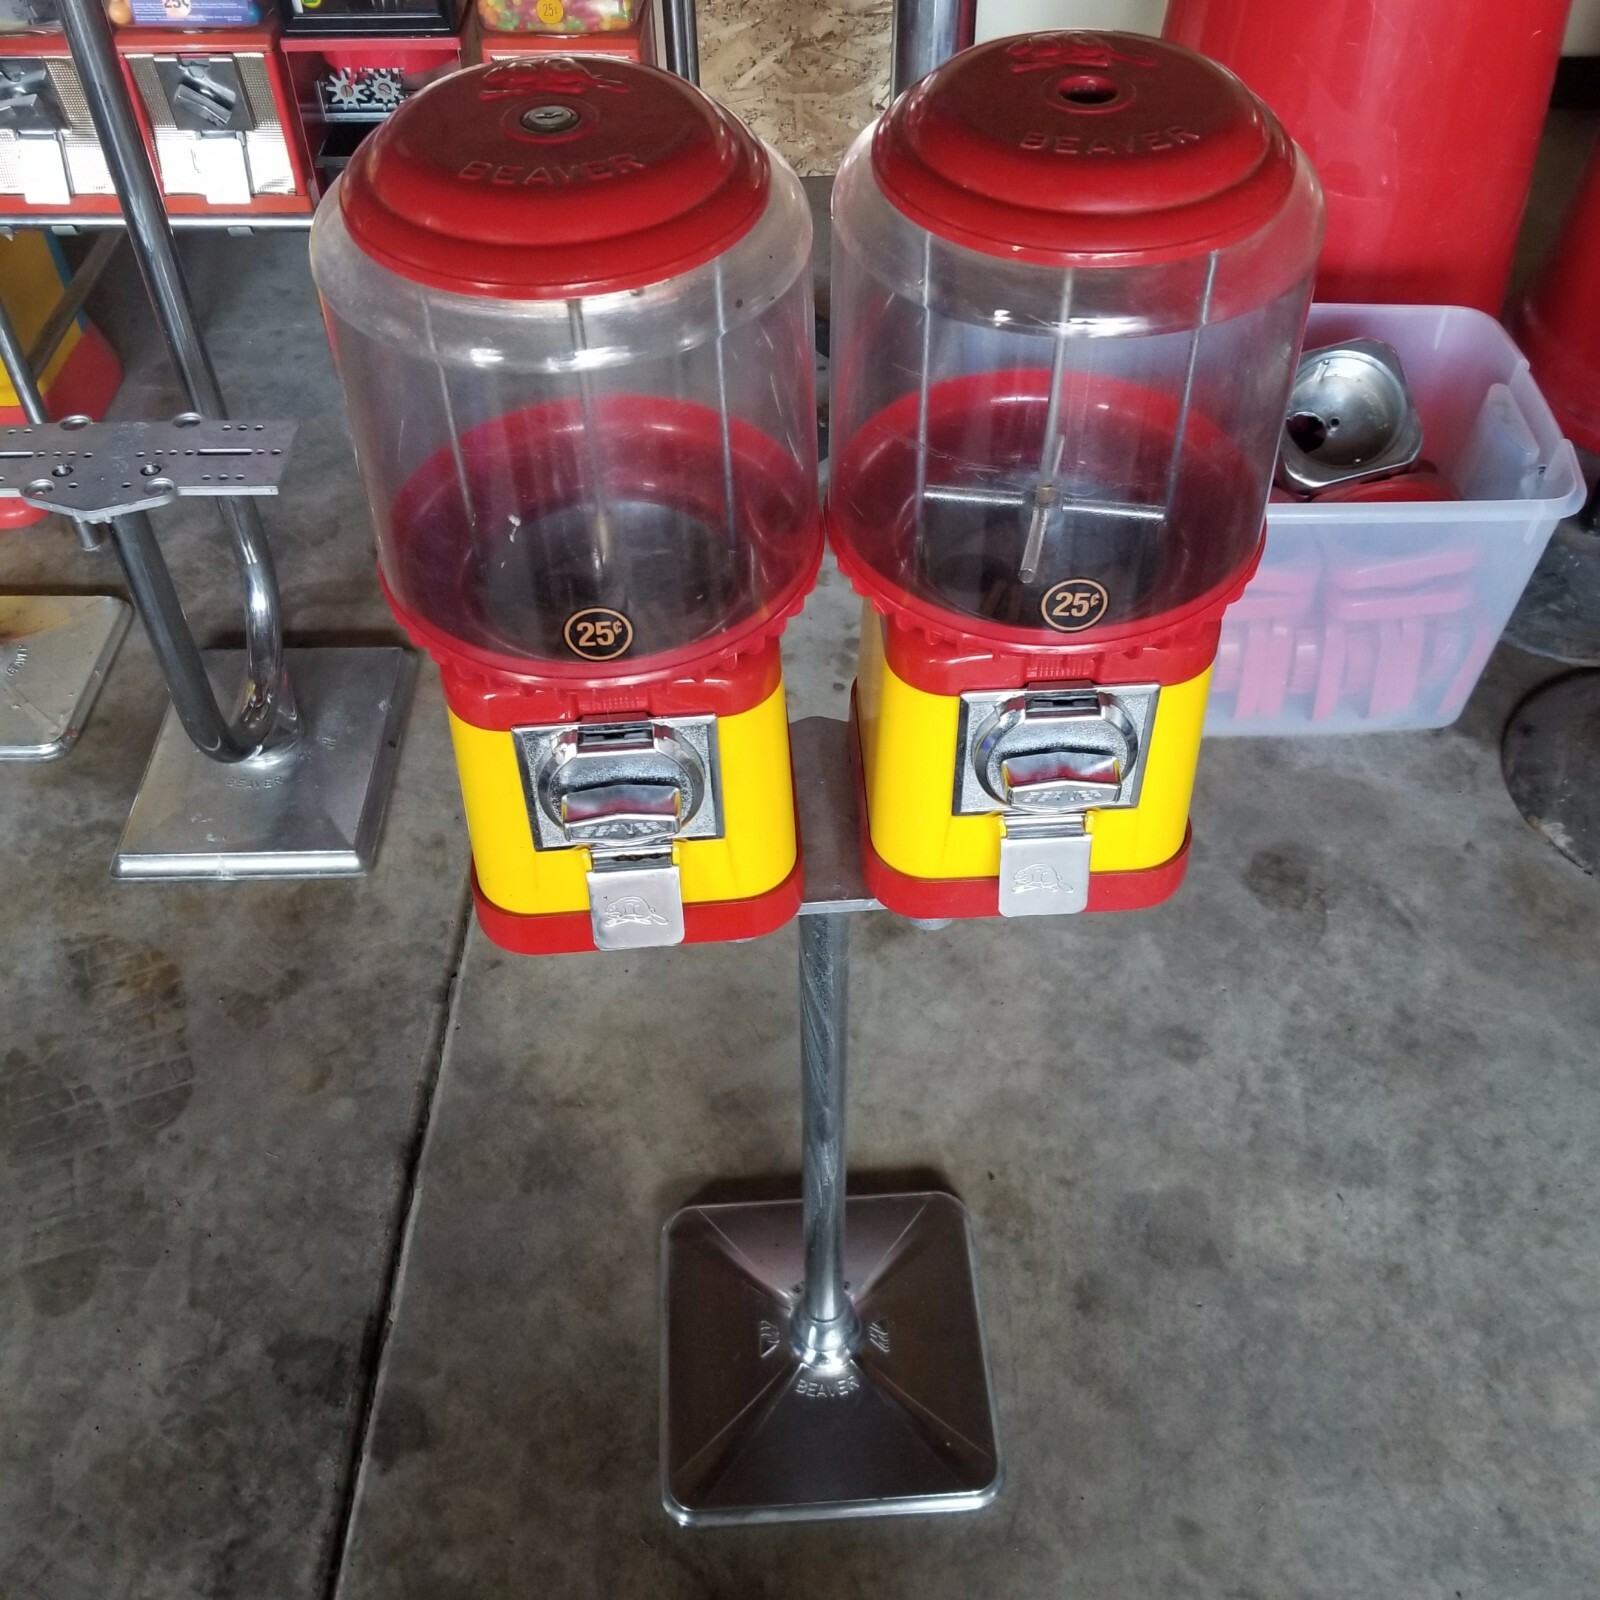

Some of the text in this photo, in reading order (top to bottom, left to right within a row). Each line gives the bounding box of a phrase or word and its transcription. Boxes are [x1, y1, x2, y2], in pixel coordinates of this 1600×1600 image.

[543, 3, 558, 16] 25¢
[1020, 126, 1200, 154] BEAVER
[457, 153, 645, 185] BEAVER
[1052, 591, 1100, 617] 25¢
[576, 620, 622, 647] 25¢
[227, 775, 284, 790] BEAVER
[795, 1375, 860, 1398] BEAVER
